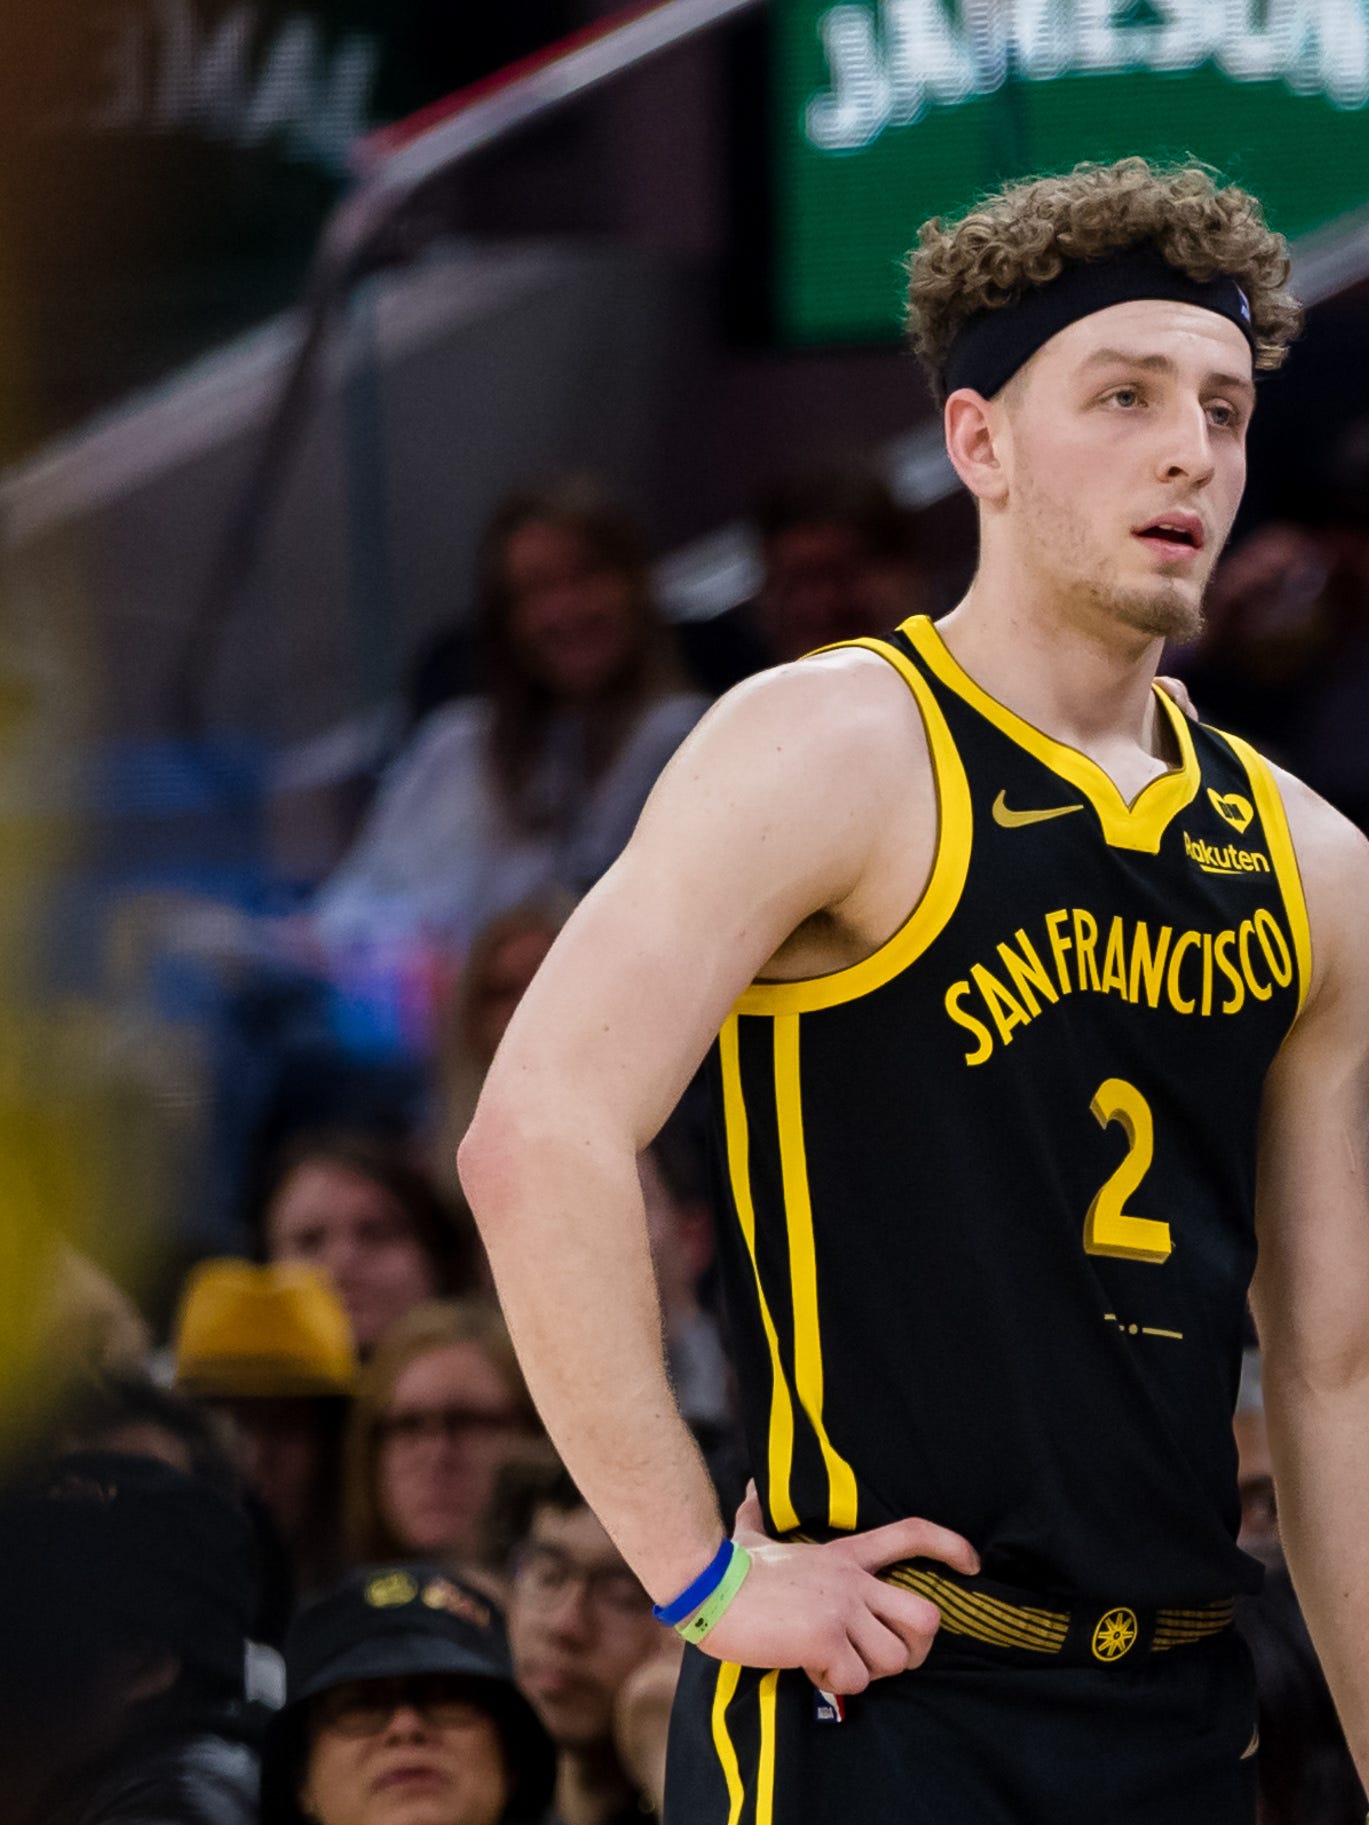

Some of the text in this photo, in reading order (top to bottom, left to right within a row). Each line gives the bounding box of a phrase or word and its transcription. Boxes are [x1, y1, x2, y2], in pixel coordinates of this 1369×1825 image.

[945, 908, 1292, 1067] SAN FRANCISCO
[1082, 1077, 1173, 1265] 2
